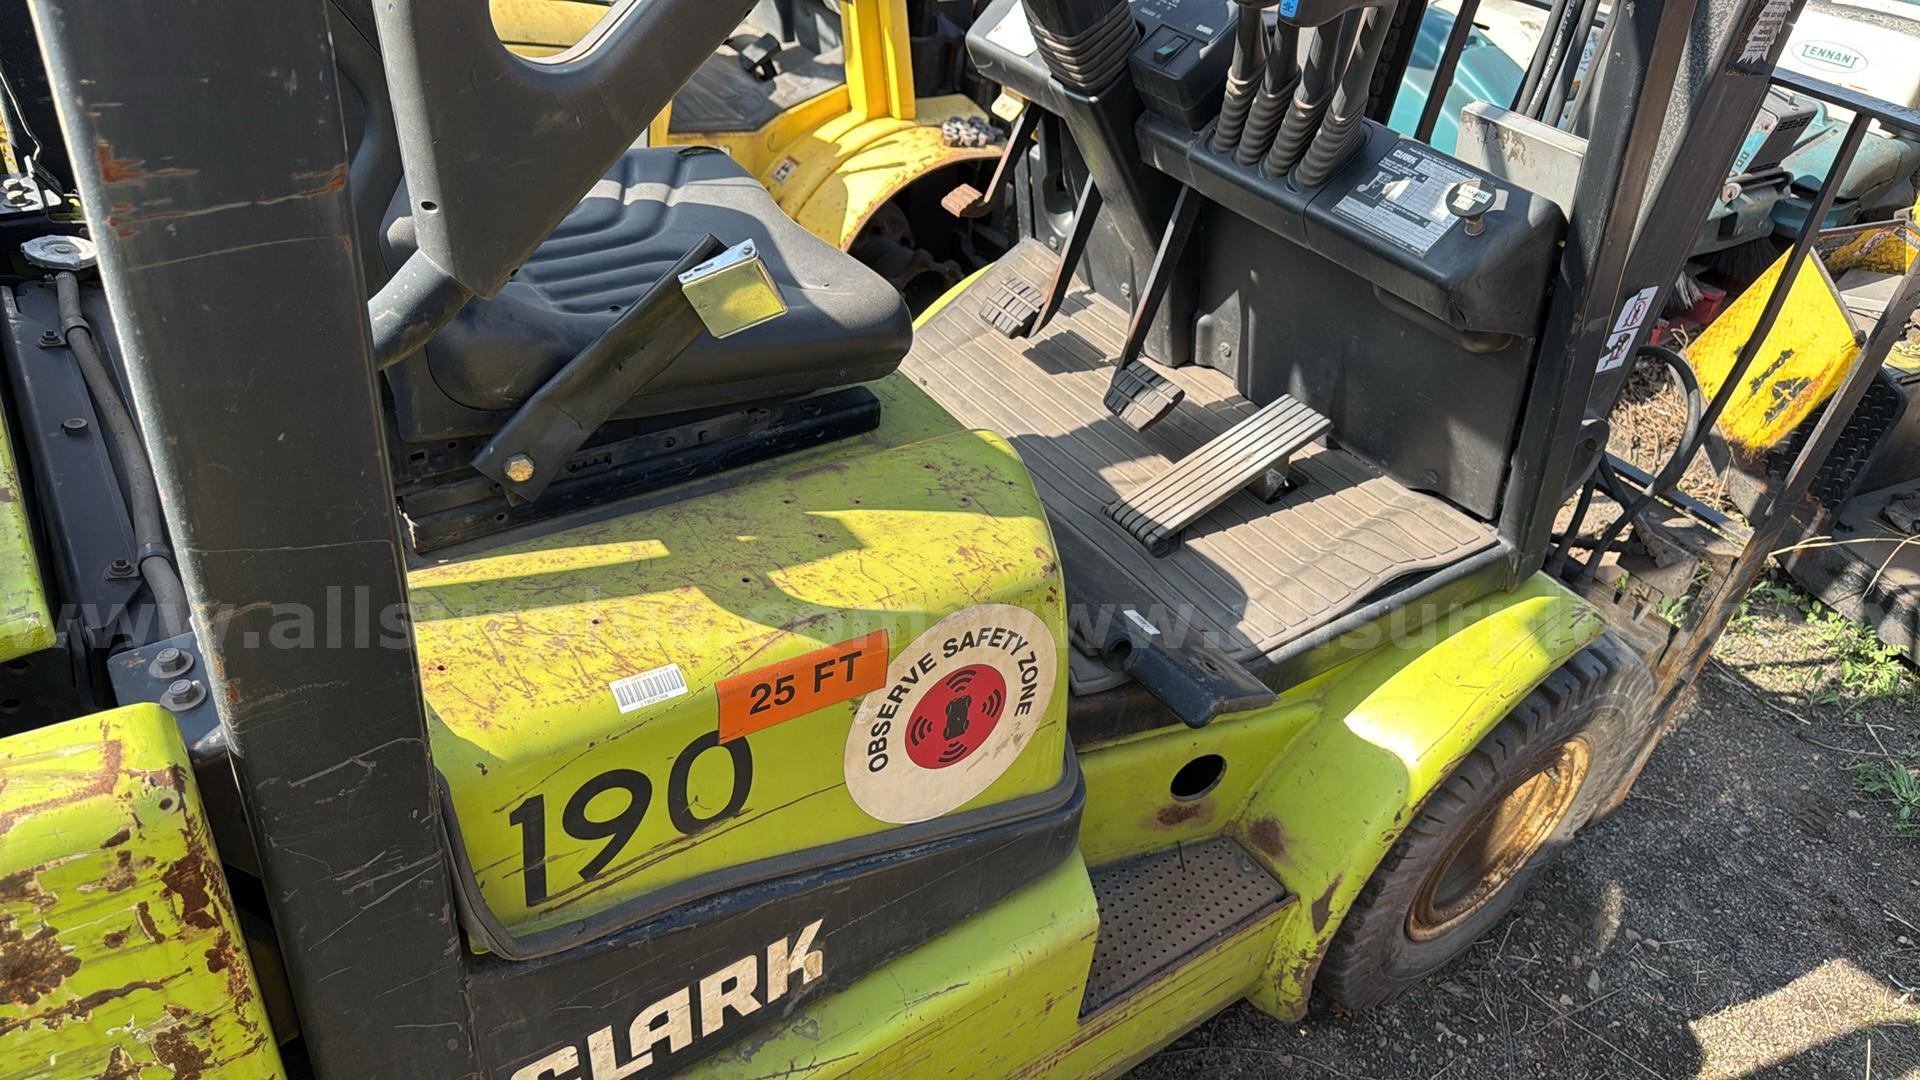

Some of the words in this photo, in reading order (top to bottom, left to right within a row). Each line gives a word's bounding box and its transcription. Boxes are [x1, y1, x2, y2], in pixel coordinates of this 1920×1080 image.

[1803, 44, 1860, 69] TENNANT
[749, 674, 796, 716] 25
[813, 650, 863, 694] FT
[868, 653, 937, 773] OBSERVE
[942, 627, 1029, 659] SAFETY
[1014, 651, 1039, 717] ZONE
[509, 729, 754, 908] 190
